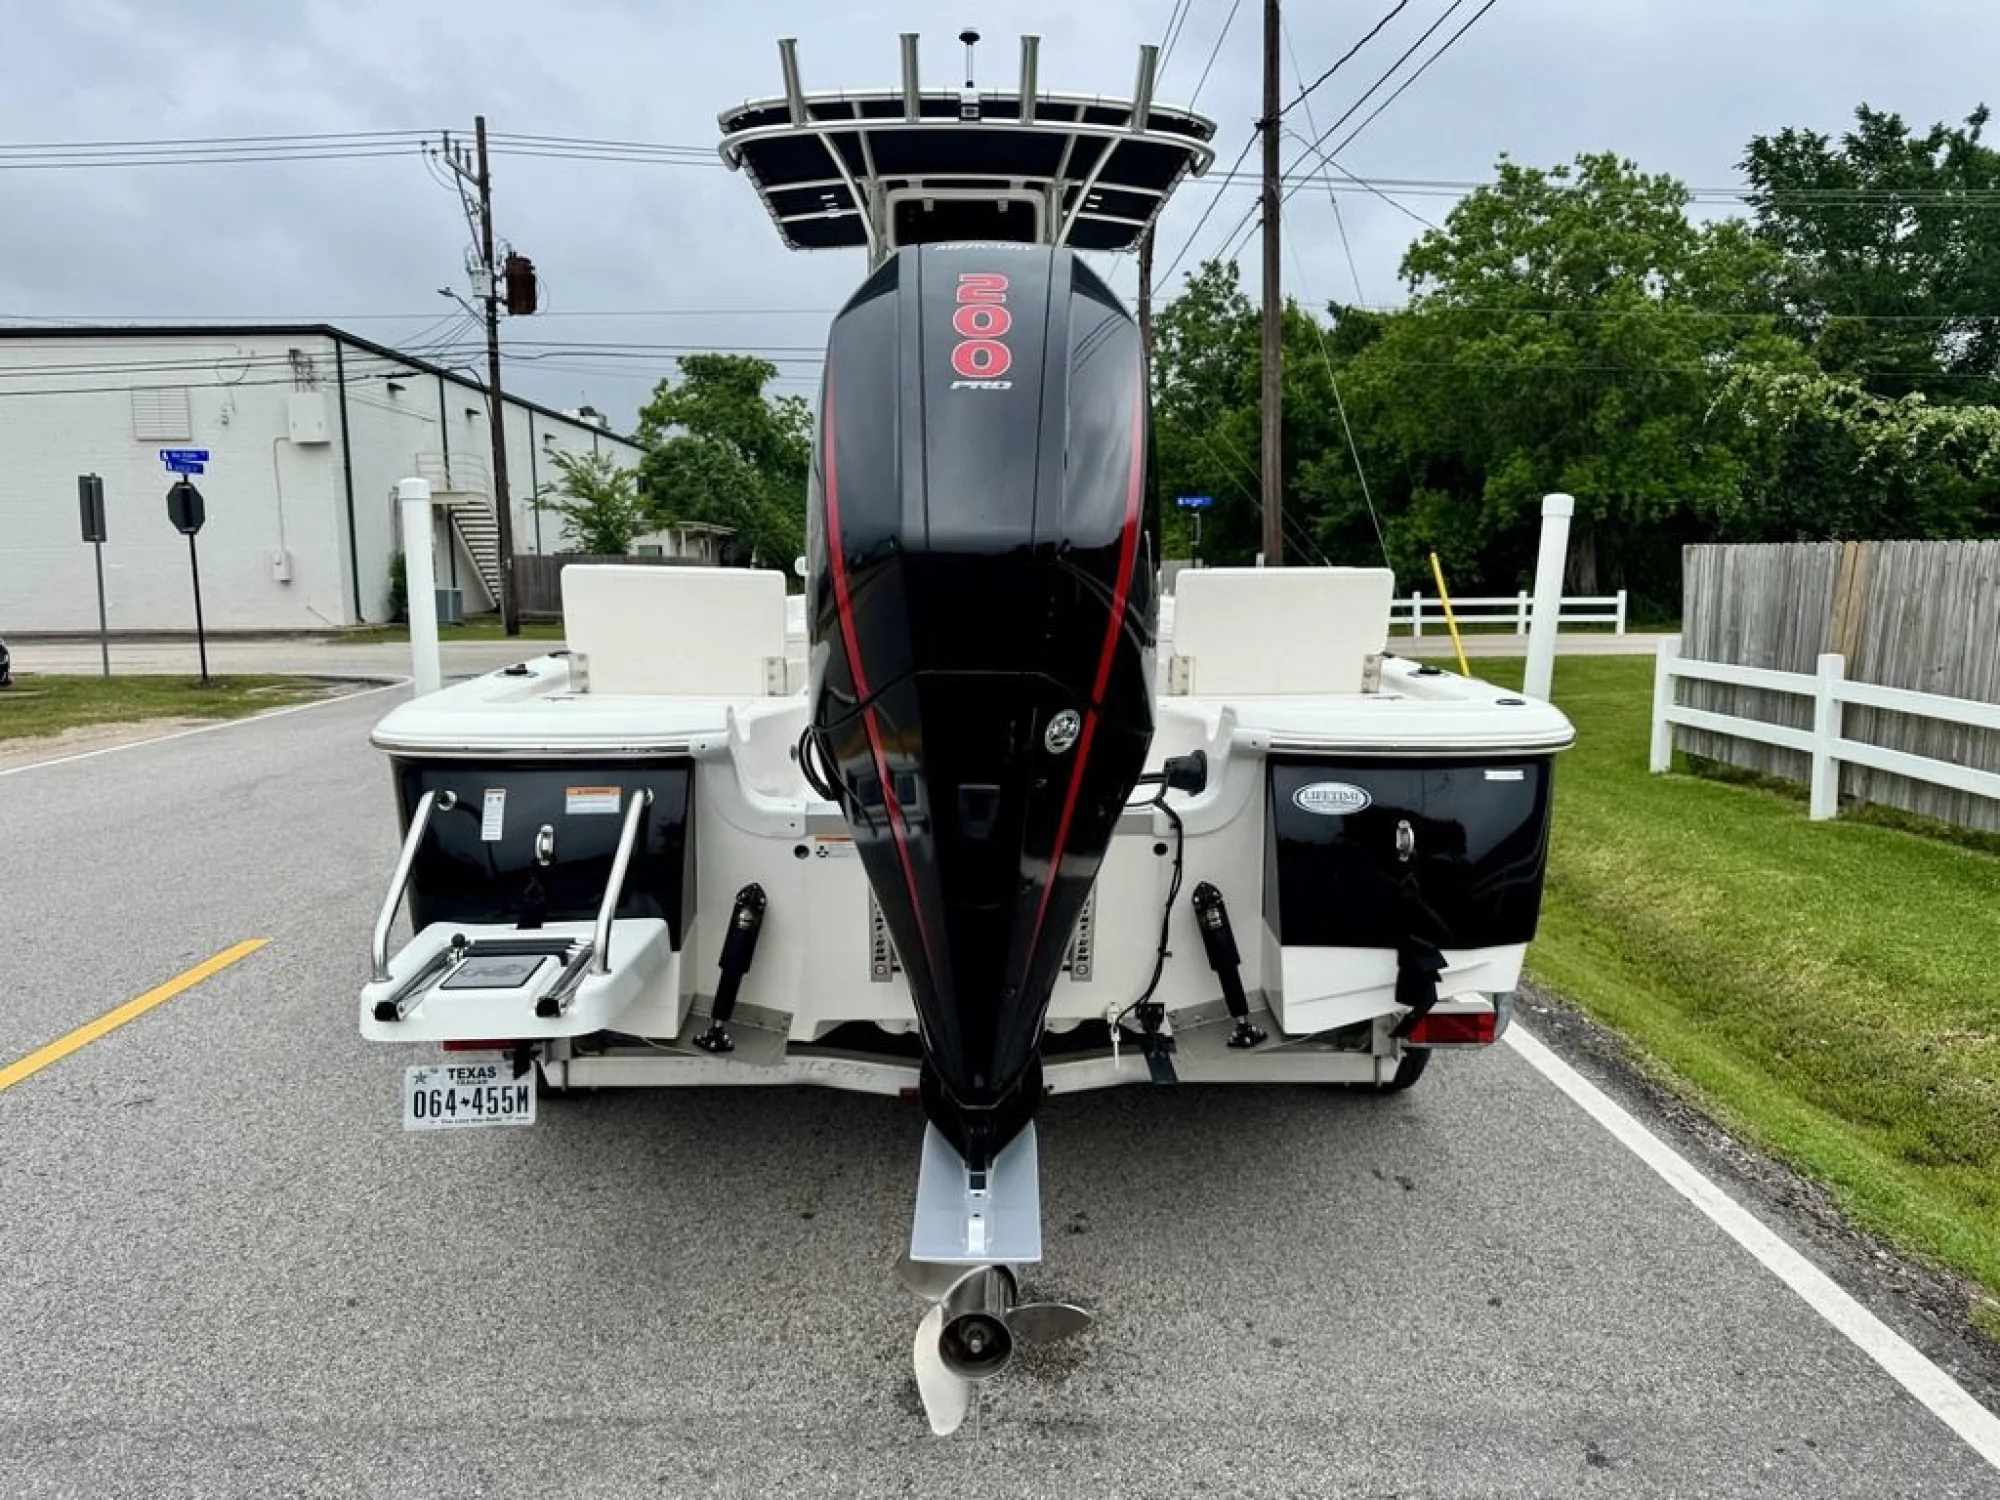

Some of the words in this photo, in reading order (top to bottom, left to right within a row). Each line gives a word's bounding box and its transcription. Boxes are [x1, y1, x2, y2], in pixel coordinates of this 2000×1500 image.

[951, 272, 1012, 378] 200
[950, 381, 1012, 390] PRO
[447, 1066, 497, 1080] TEXAS
